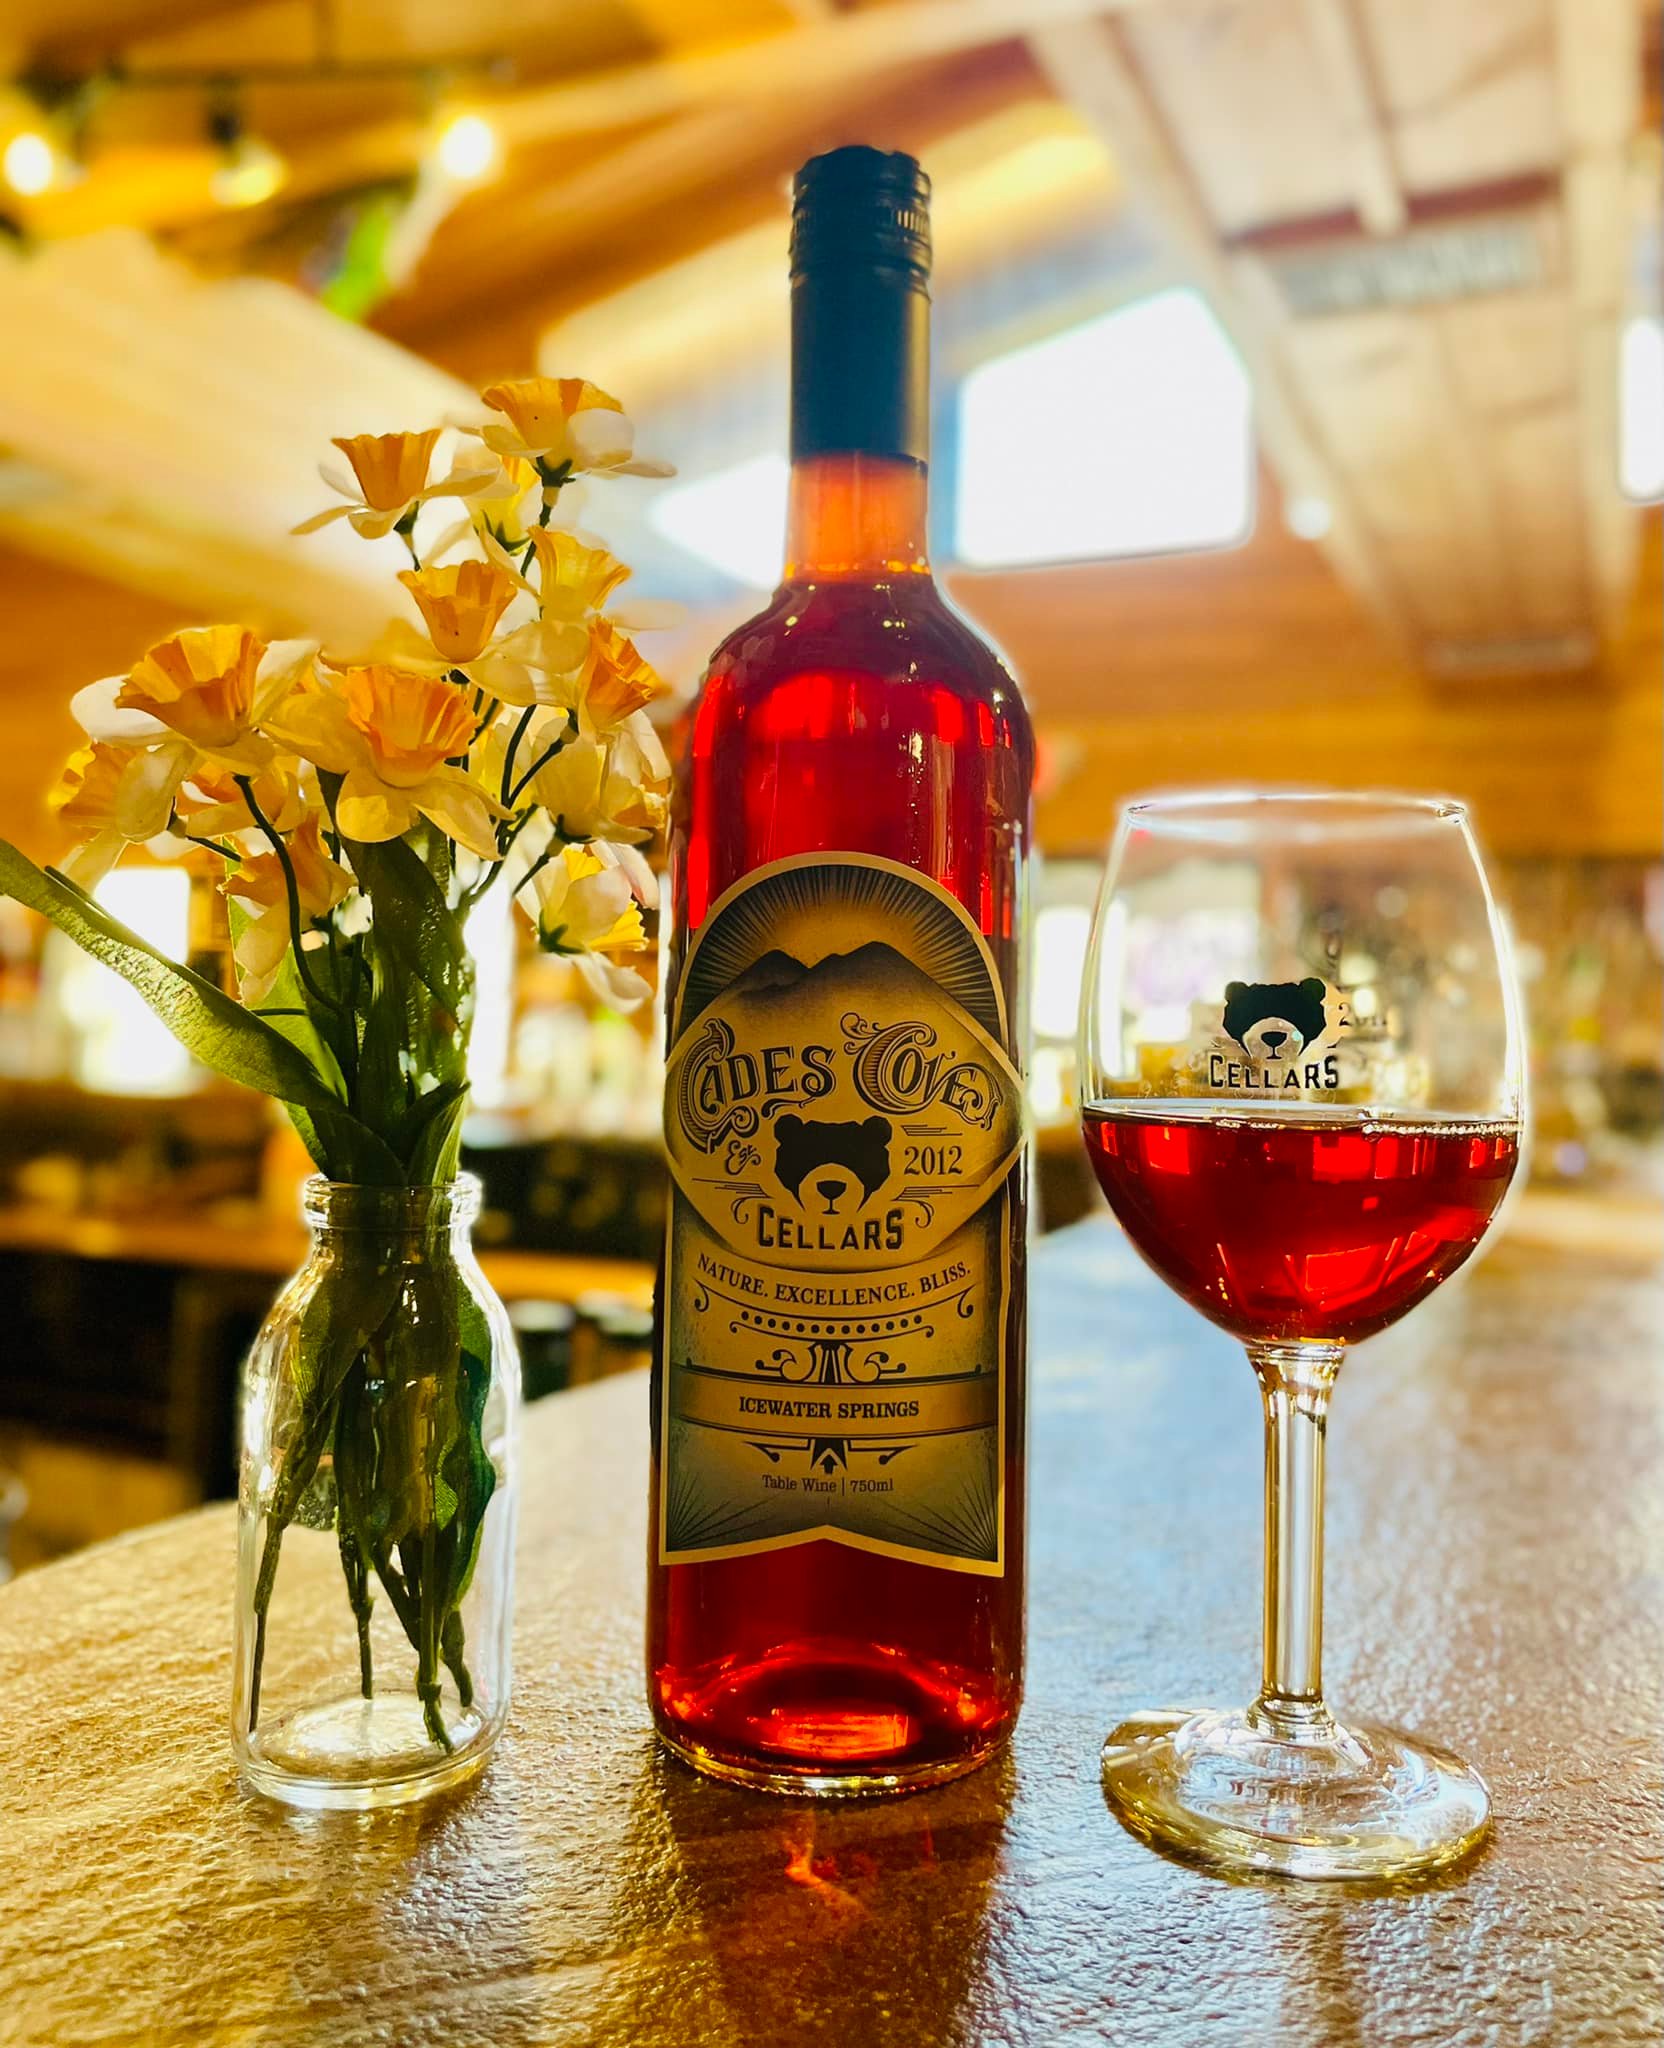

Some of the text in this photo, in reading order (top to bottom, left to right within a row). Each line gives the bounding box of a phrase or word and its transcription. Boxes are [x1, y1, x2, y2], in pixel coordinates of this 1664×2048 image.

[679, 1012, 1003, 1153] CADES COVE
[1210, 1054, 1338, 1089] CELLARS
[725, 1140, 963, 1175] Est. 2012
[757, 1204, 904, 1250] CELLARS
[697, 1253, 970, 1306] NATURE. EXCELLENCE. BLISS.
[739, 1396, 920, 1419] ICEWATER SPRINGS
[762, 1474, 797, 1490] Table
[801, 1477, 837, 1492] Wine
[850, 1478, 894, 1492] 750ml
